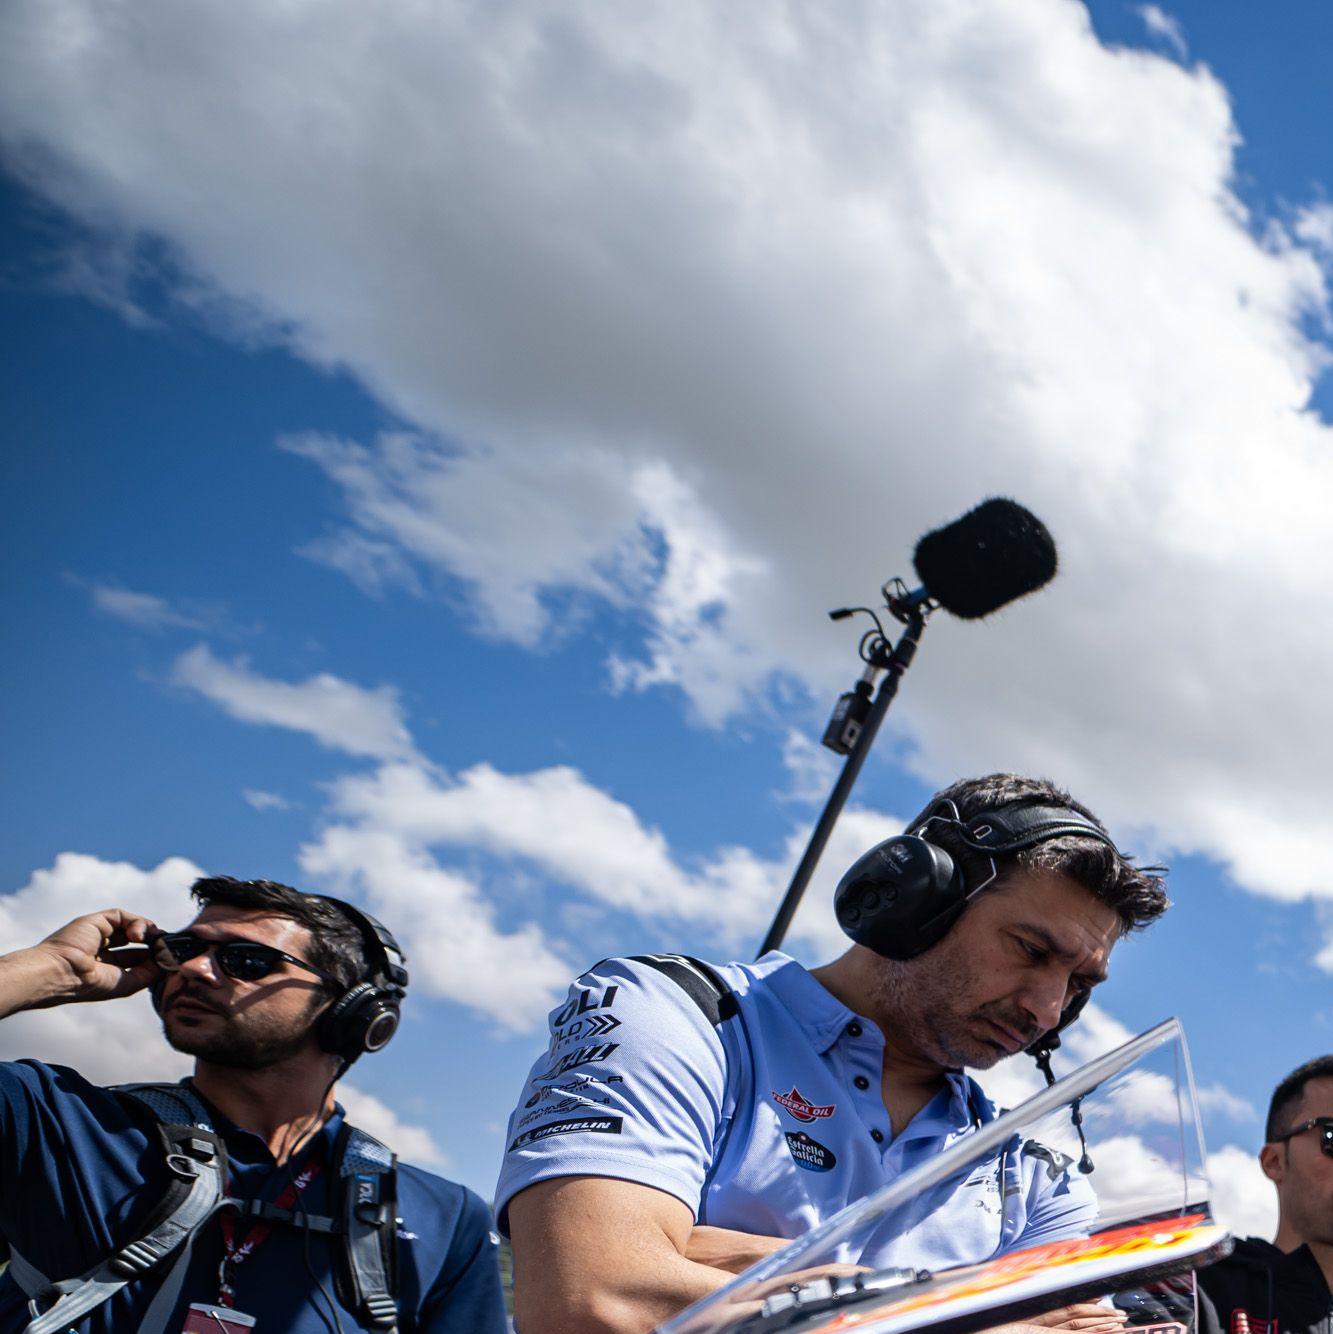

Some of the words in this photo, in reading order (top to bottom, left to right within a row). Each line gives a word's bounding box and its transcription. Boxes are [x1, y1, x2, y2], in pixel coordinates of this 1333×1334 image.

[812, 1107, 829, 1116] OIL
[534, 1121, 612, 1138] MICHELIN
[787, 1135, 825, 1158] Estrella
